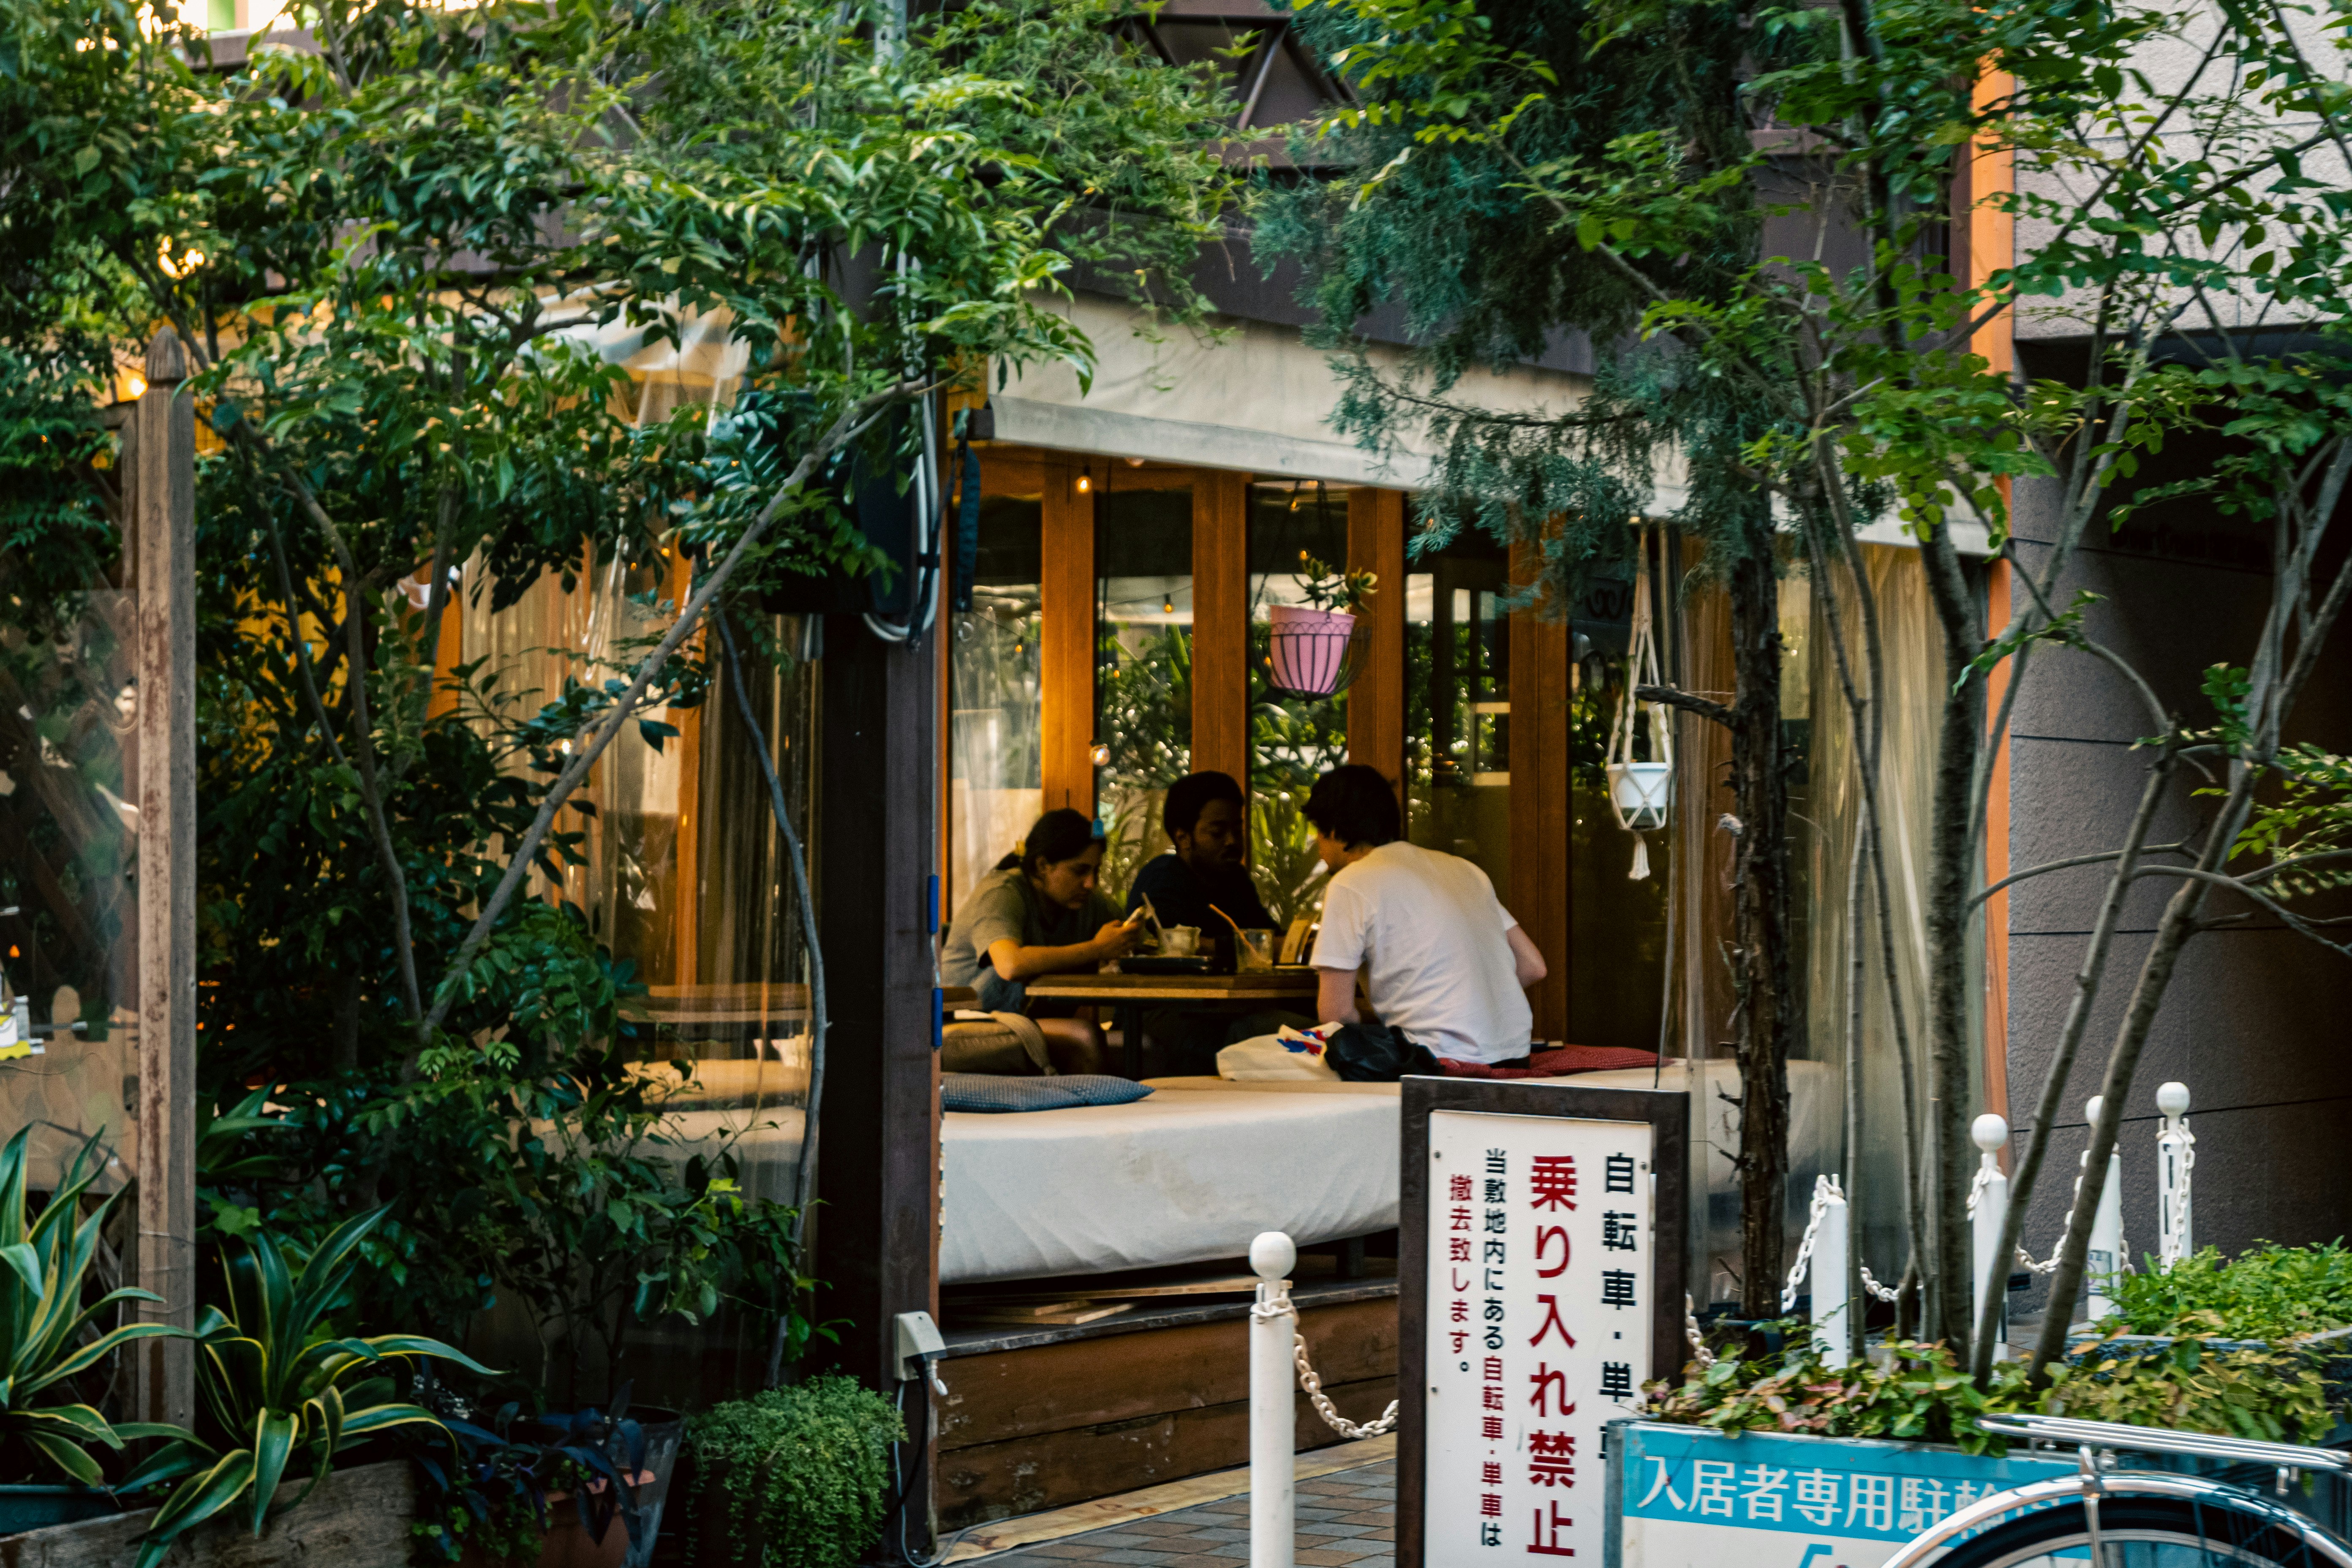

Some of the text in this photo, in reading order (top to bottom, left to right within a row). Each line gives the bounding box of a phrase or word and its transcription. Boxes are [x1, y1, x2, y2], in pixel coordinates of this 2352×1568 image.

[1449, 1174, 1473, 1372] 撤去致します。
[1480, 1148, 1507, 1547] 当敷地内にある自転車・単車は
[1527, 1155, 1578, 1557] 乗り入れ禁止
[1598, 1152, 1637, 1459] 自転車・単
